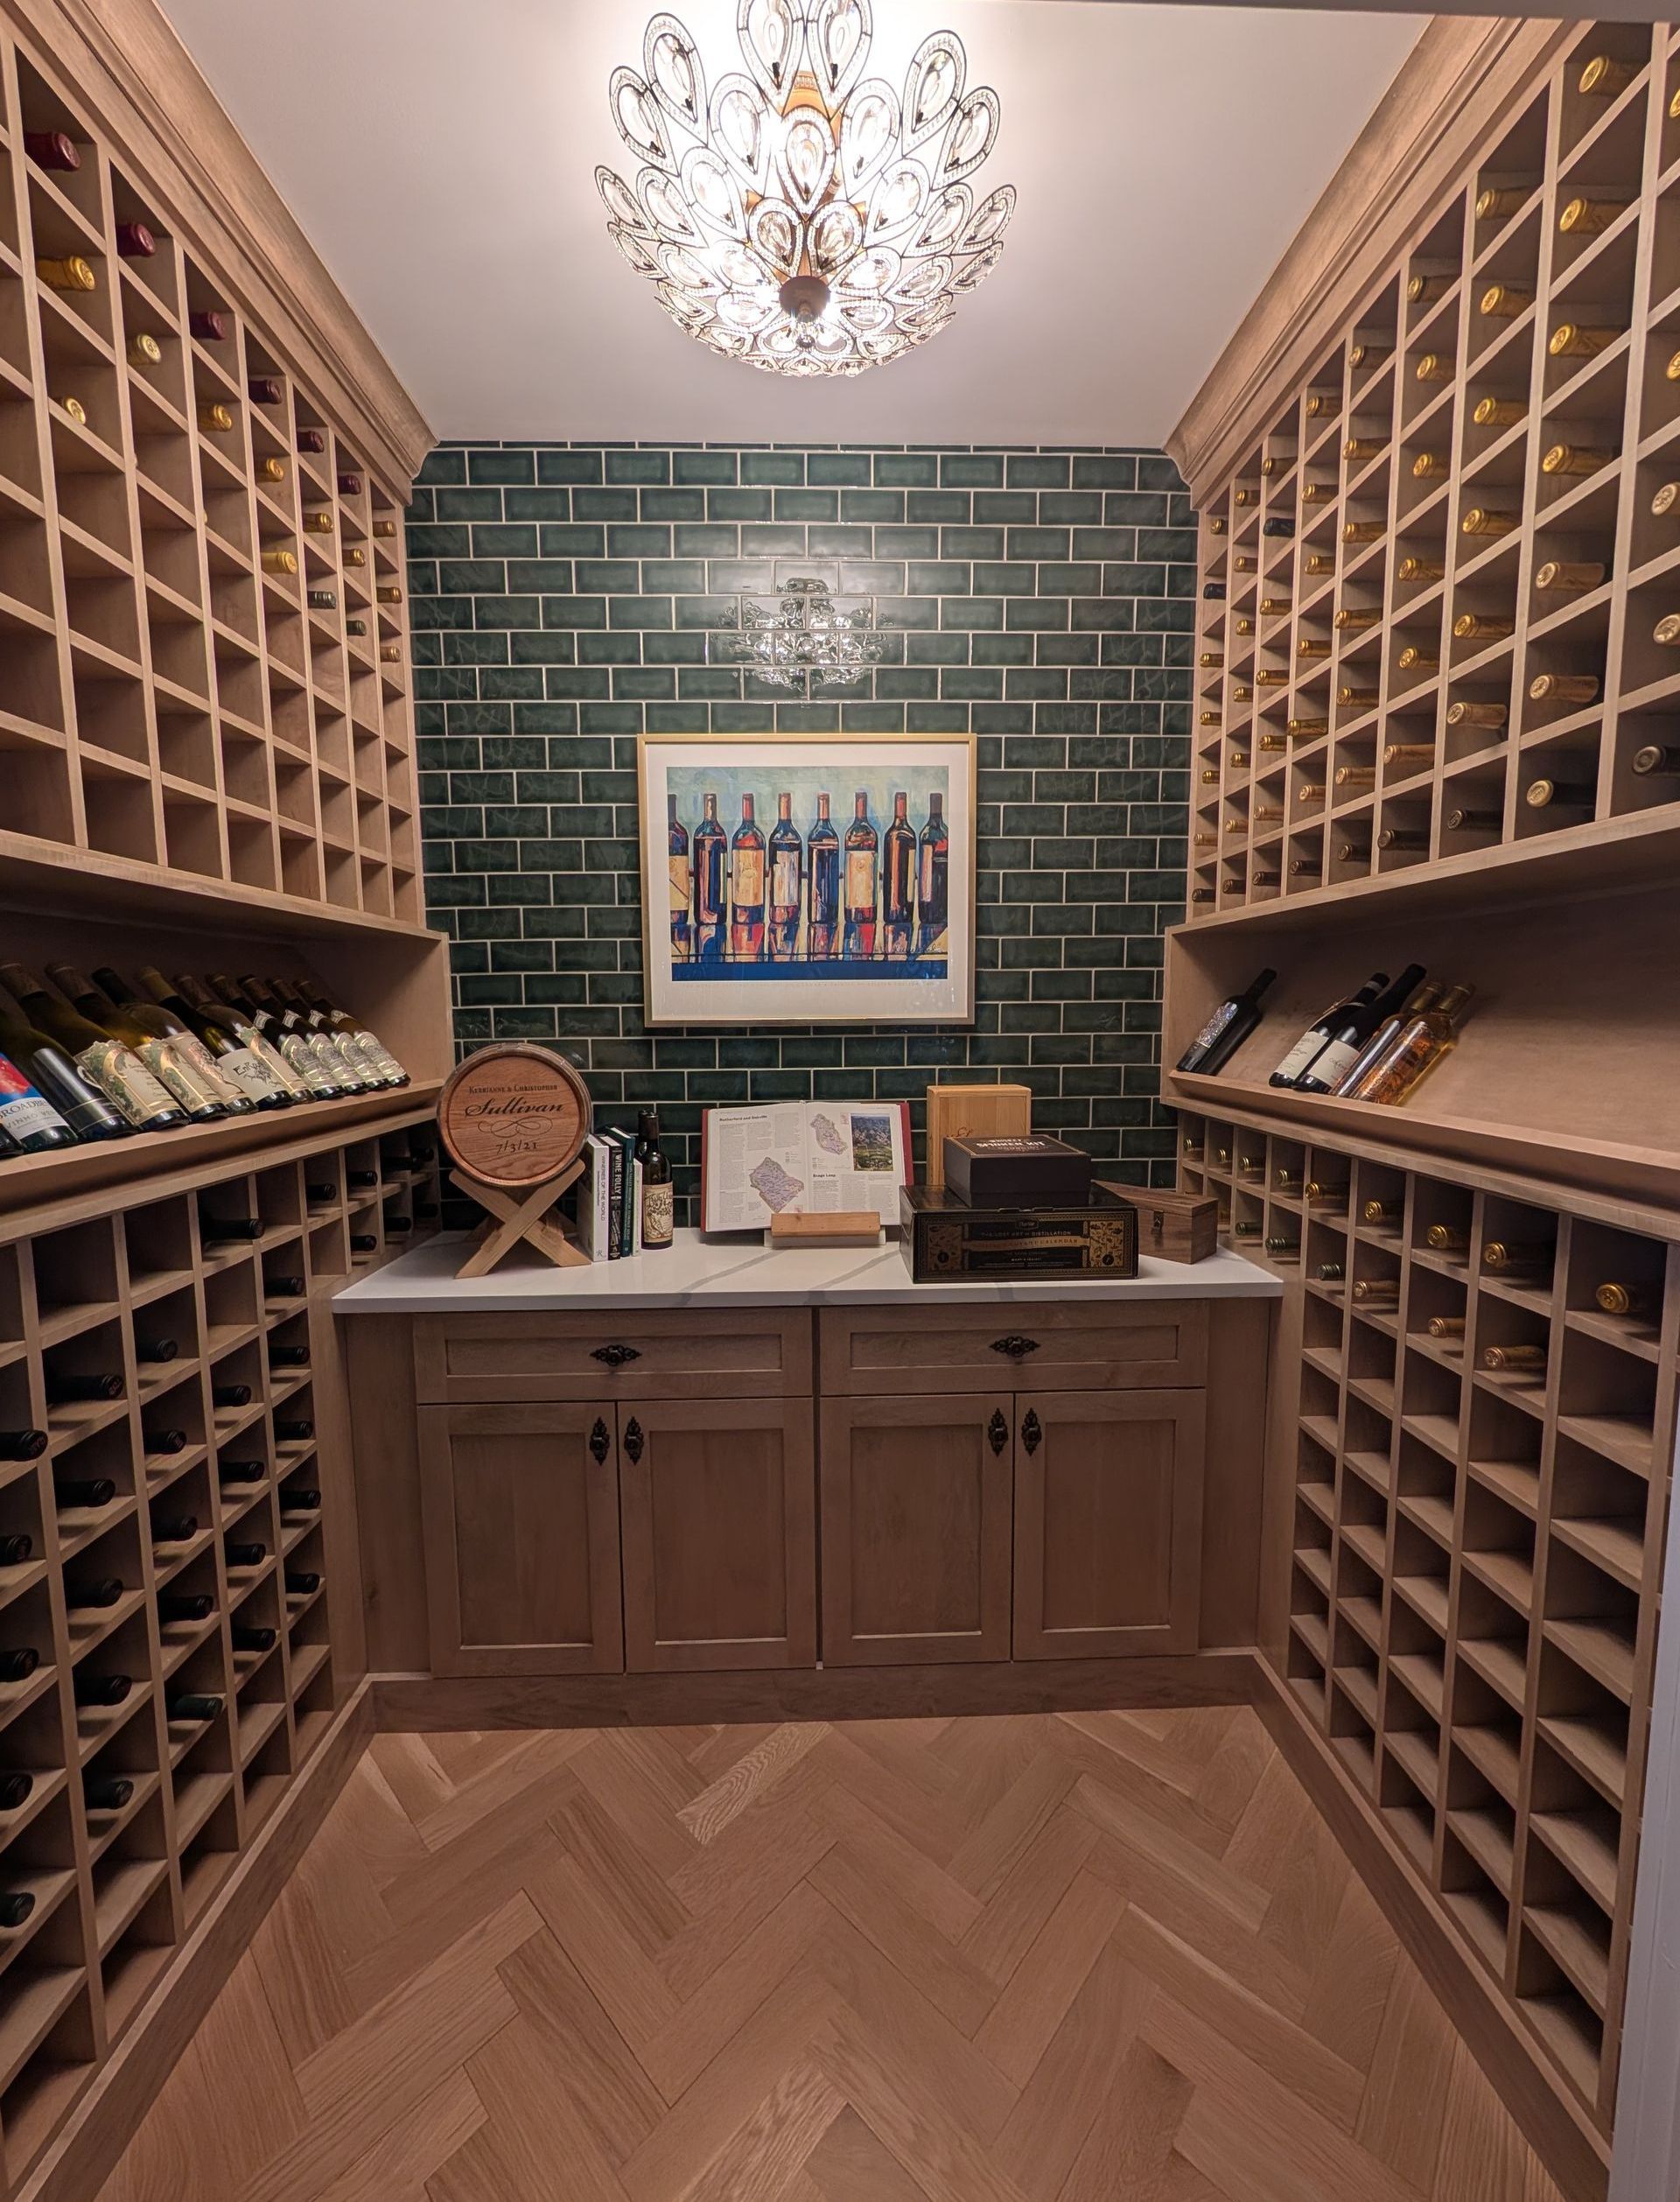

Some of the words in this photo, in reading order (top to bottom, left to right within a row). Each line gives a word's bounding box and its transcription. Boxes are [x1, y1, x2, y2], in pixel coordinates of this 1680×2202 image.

[514, 1083, 558, 1093] CHRISTOPHER
[465, 1097, 564, 1117] Sullivan
[6, 1113, 38, 1129] VINHO
[495, 1140, 539, 1155] 7/3/21
